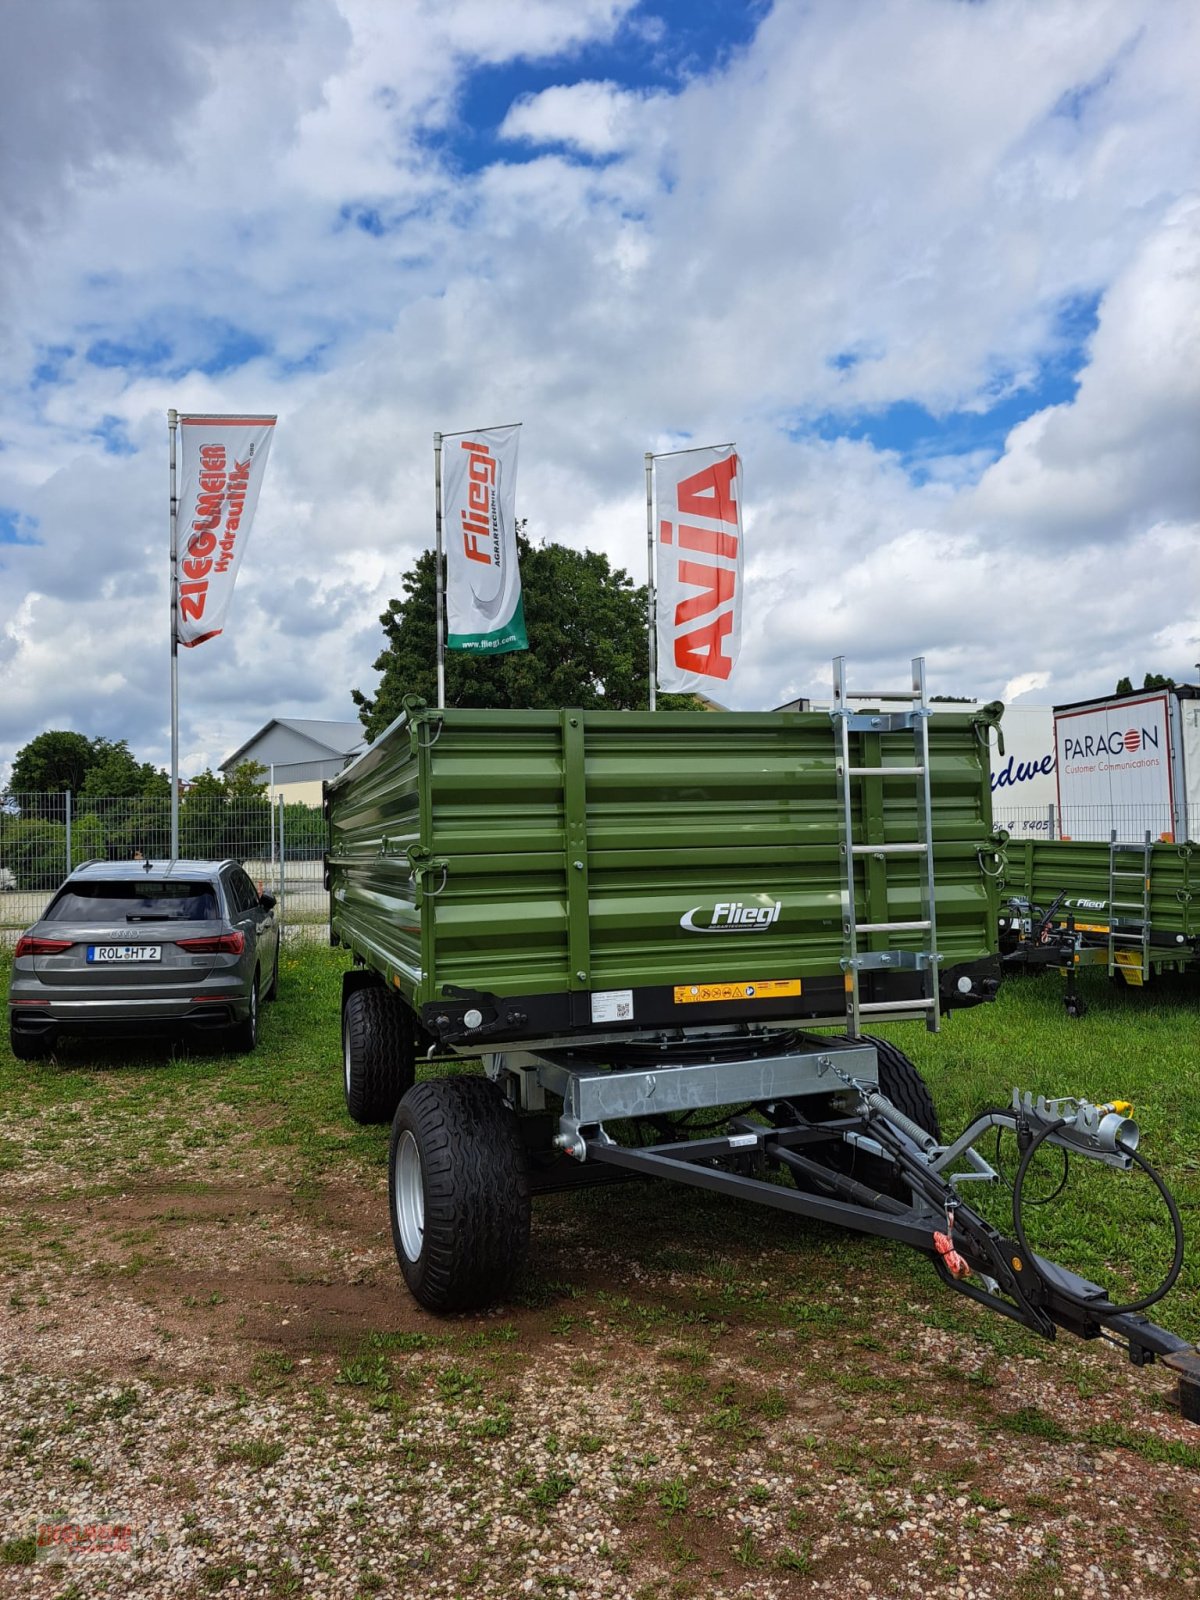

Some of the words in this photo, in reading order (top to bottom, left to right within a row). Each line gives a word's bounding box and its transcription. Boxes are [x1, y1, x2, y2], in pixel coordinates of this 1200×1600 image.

[214, 458, 250, 572] Hydraulik
[461, 441, 497, 565] Fliegl
[180, 443, 226, 622] ZIEGLMEIER
[491, 490, 501, 567] AGRARTECHNIK
[462, 635, 516, 649] www.fliegl.com
[1064, 725, 1158, 760] PARAGON
[1065, 764, 1096, 774] Customer
[1098, 758, 1160, 771] Communications
[1022, 820, 1055, 831] 8405
[711, 901, 781, 927] Fliegl
[99, 948, 122, 959] ROL
[131, 947, 147, 958] HT
[149, 947, 157, 959] 2
